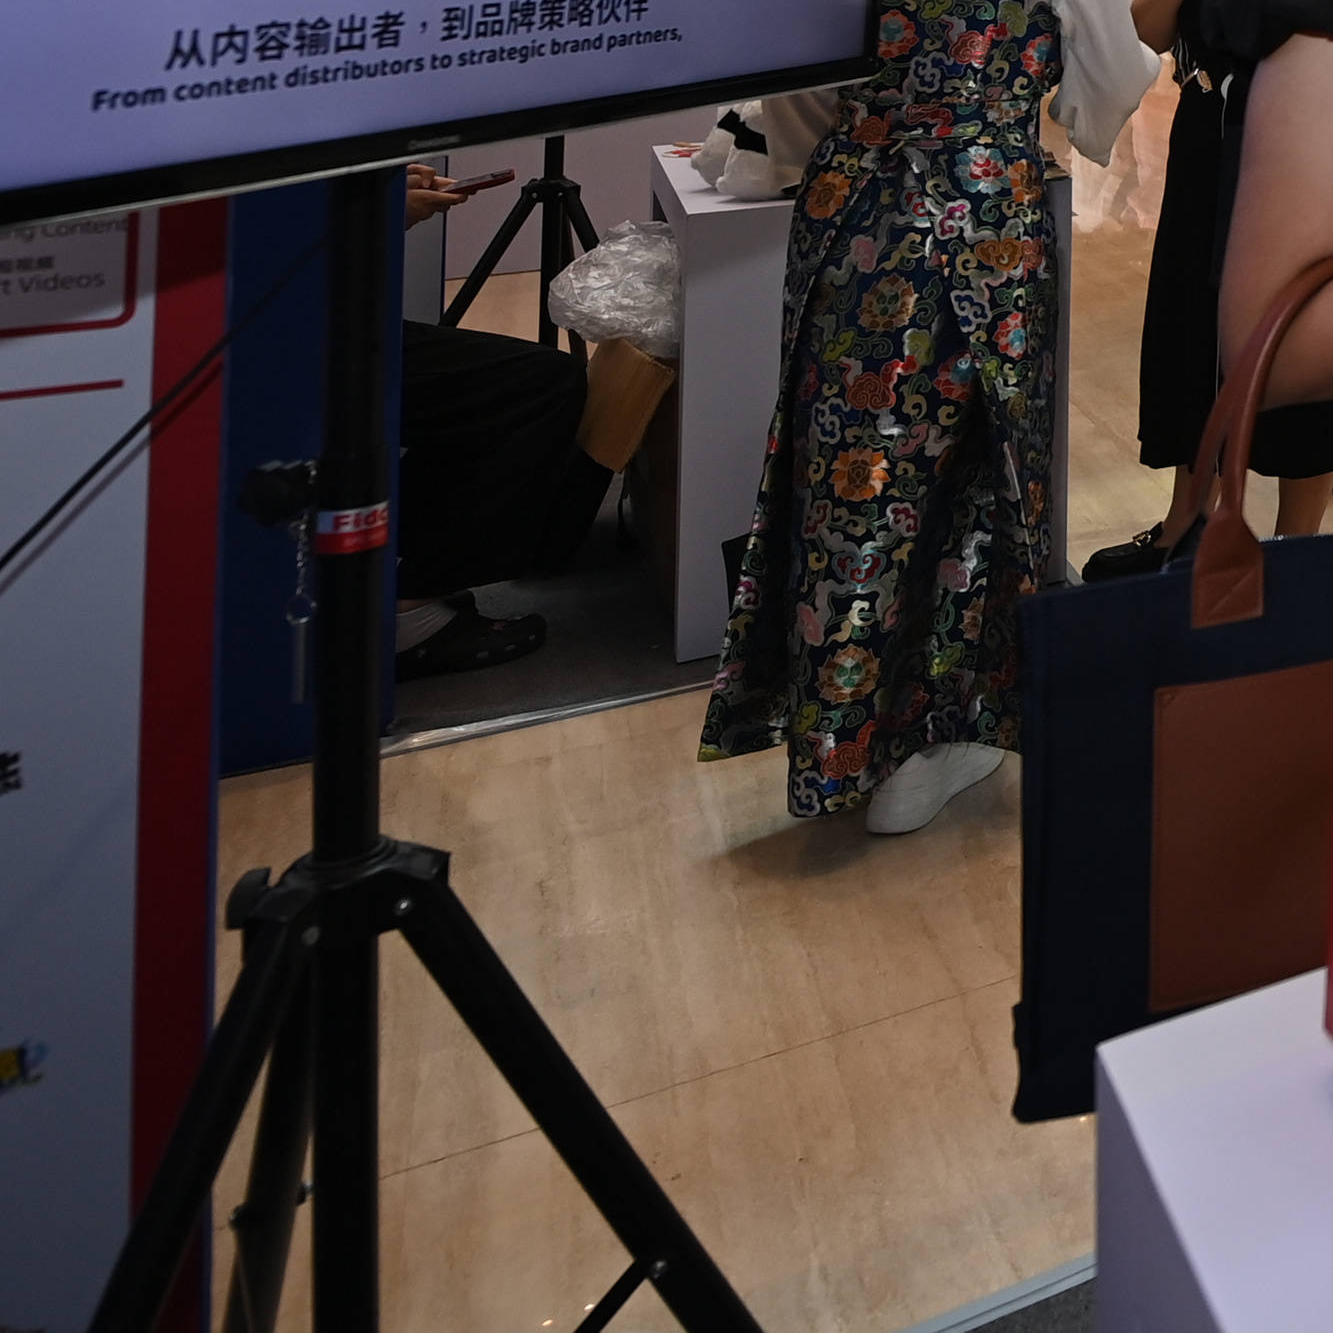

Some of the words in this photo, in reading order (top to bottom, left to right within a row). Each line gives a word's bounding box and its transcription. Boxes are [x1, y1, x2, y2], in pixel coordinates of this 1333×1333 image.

[91, 86, 167, 112] From
[173, 72, 278, 103] content
[284, 54, 425, 89] distributors
[430, 51, 453, 71] to
[457, 38, 546, 67] strategic
[550, 30, 602, 57] brand
[606, 25, 683, 52] partners,
[20, 272, 105, 295] Videos
